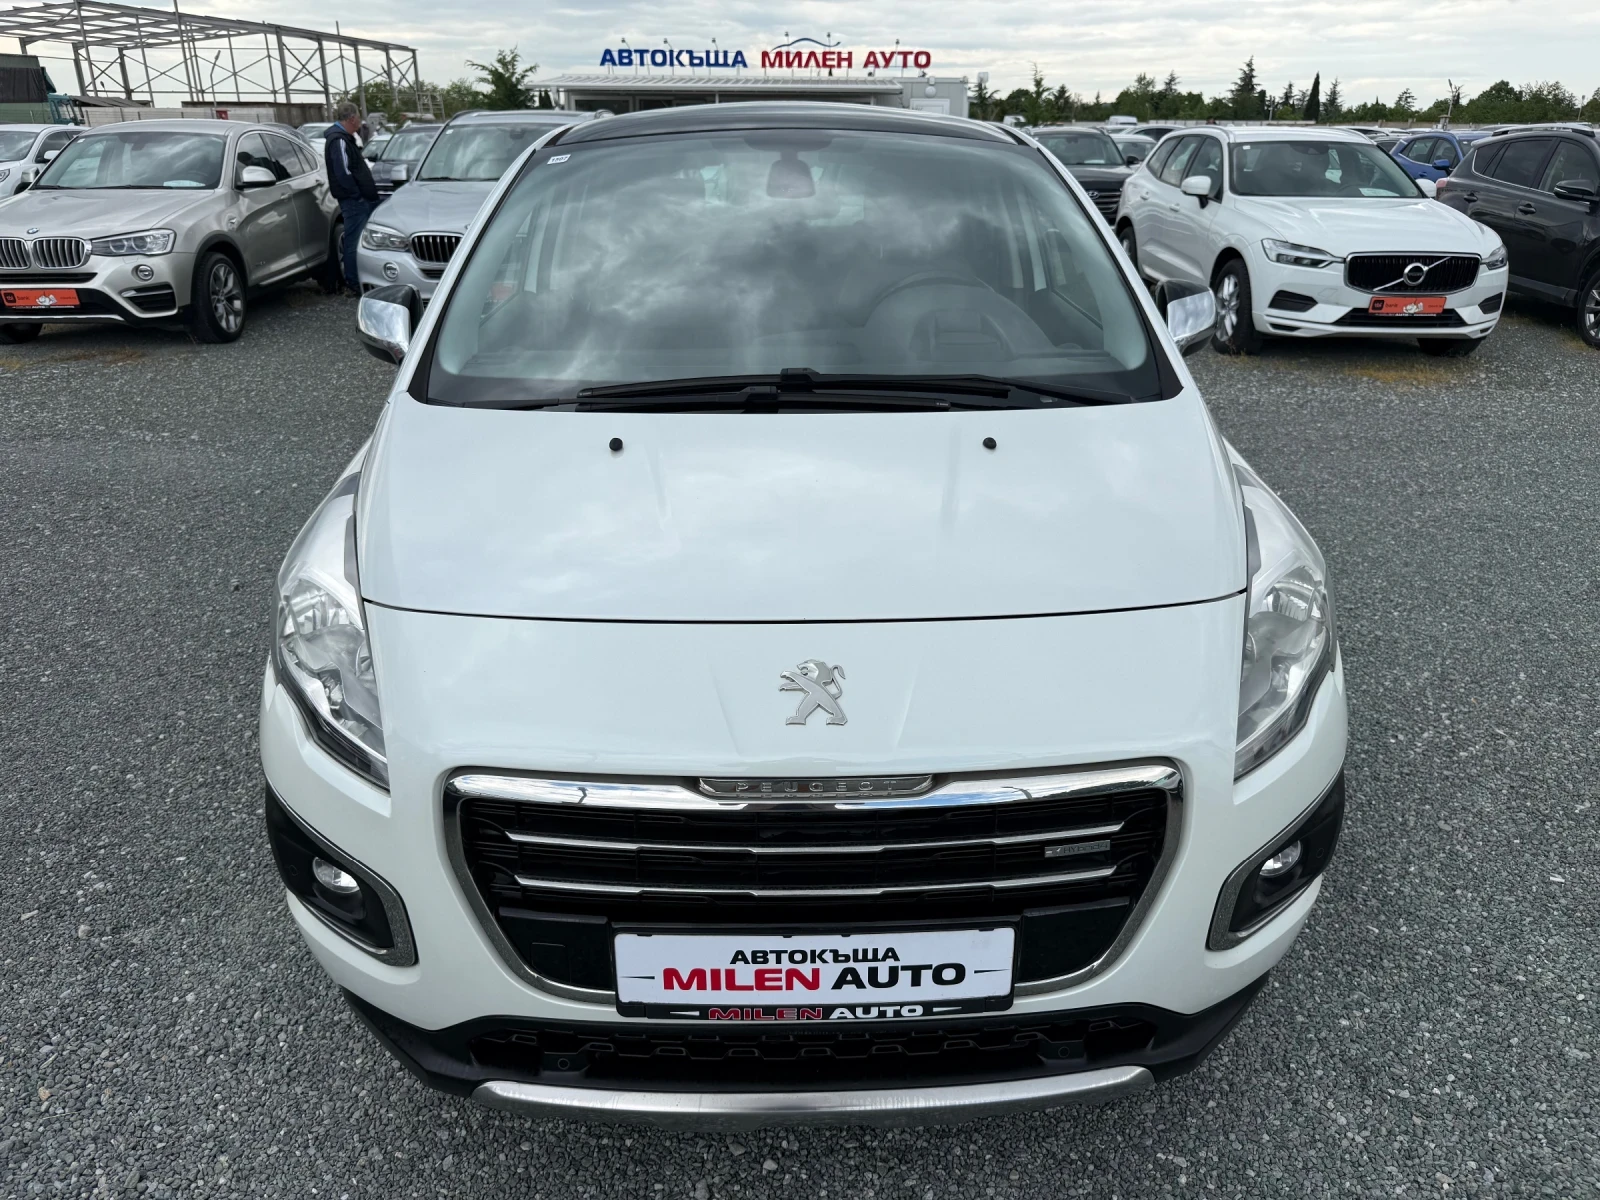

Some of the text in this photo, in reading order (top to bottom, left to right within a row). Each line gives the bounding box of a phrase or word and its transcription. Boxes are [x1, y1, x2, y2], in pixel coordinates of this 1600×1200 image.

[761, 51, 853, 69] МИЛЕН
[863, 51, 931, 69] АУТО
[735, 780, 897, 792] PEUGEOT
[662, 962, 966, 991] MILEN AUTO
[708, 1005, 924, 1020] MILEN AUTO
